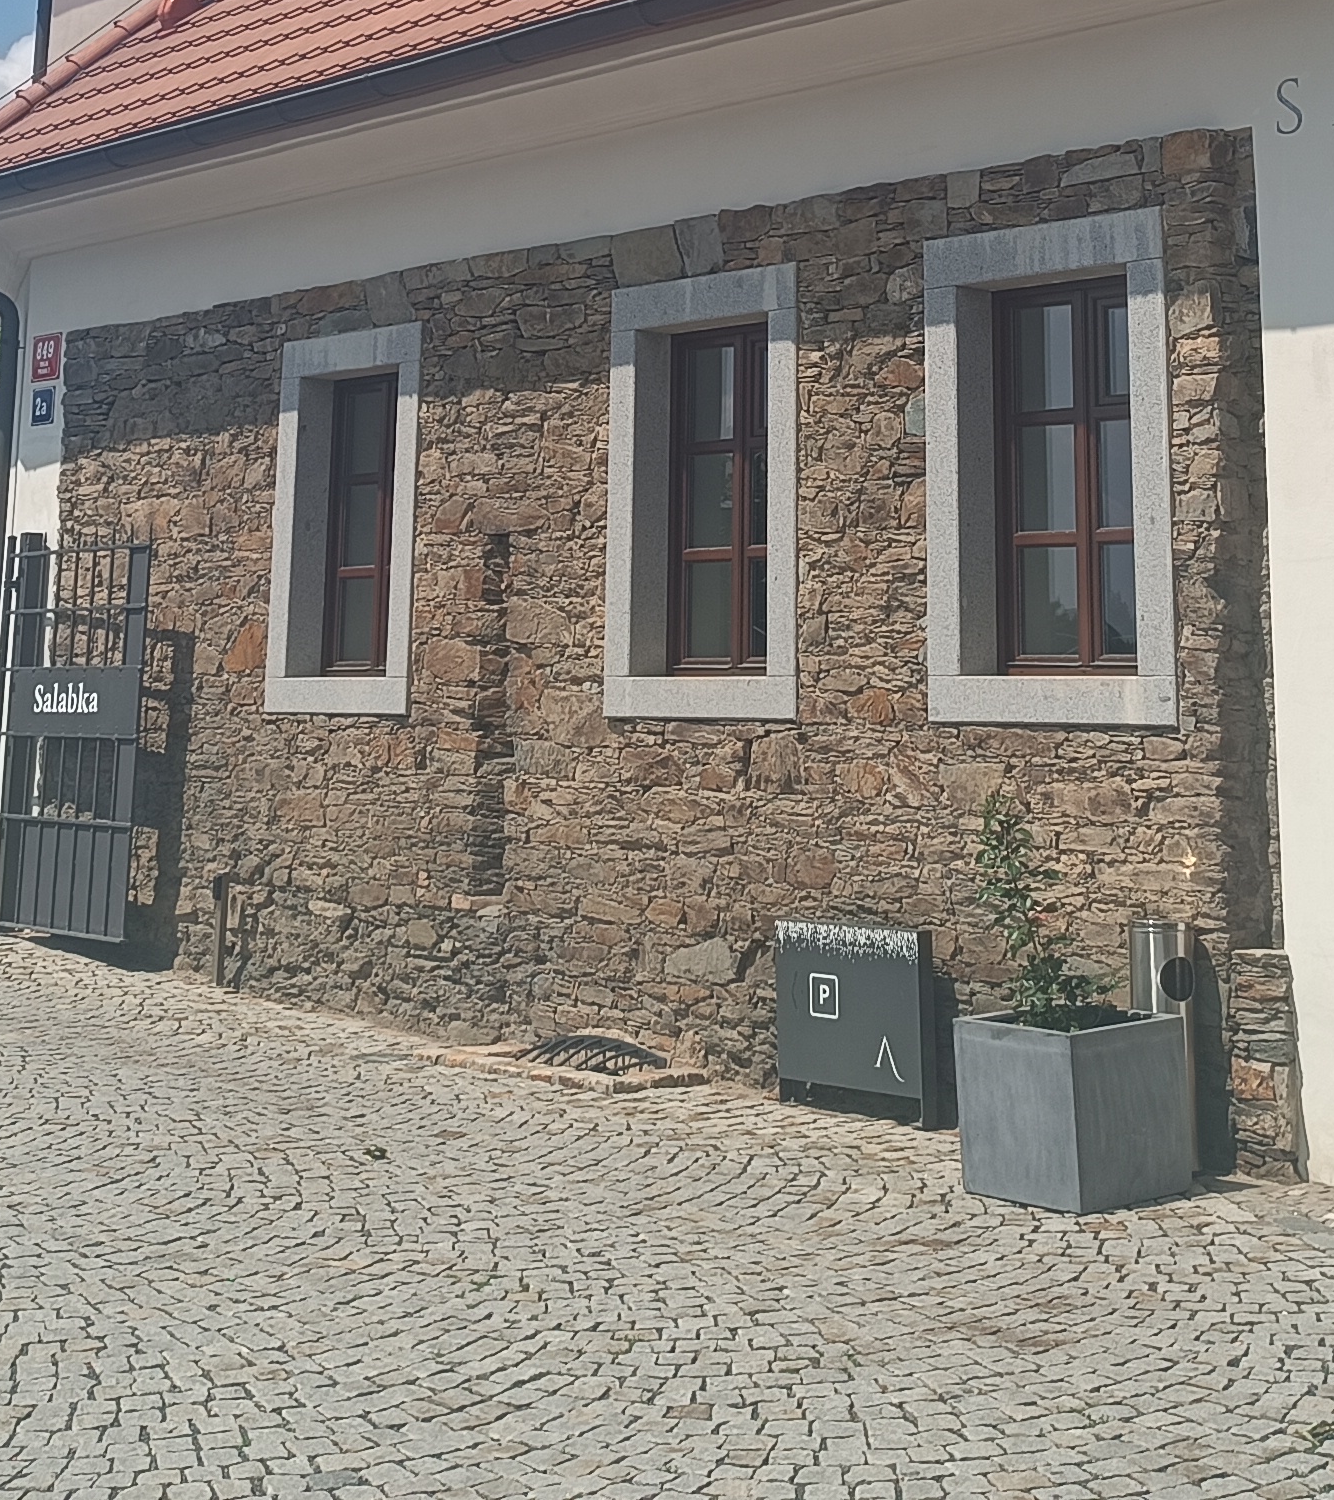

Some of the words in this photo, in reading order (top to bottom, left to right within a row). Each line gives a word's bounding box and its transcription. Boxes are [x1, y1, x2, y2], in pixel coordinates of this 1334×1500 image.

[36, 340, 55, 360] 849
[35, 397, 47, 415] 2a
[33, 682, 98, 714] Salabka
[819, 984, 830, 1005] P
